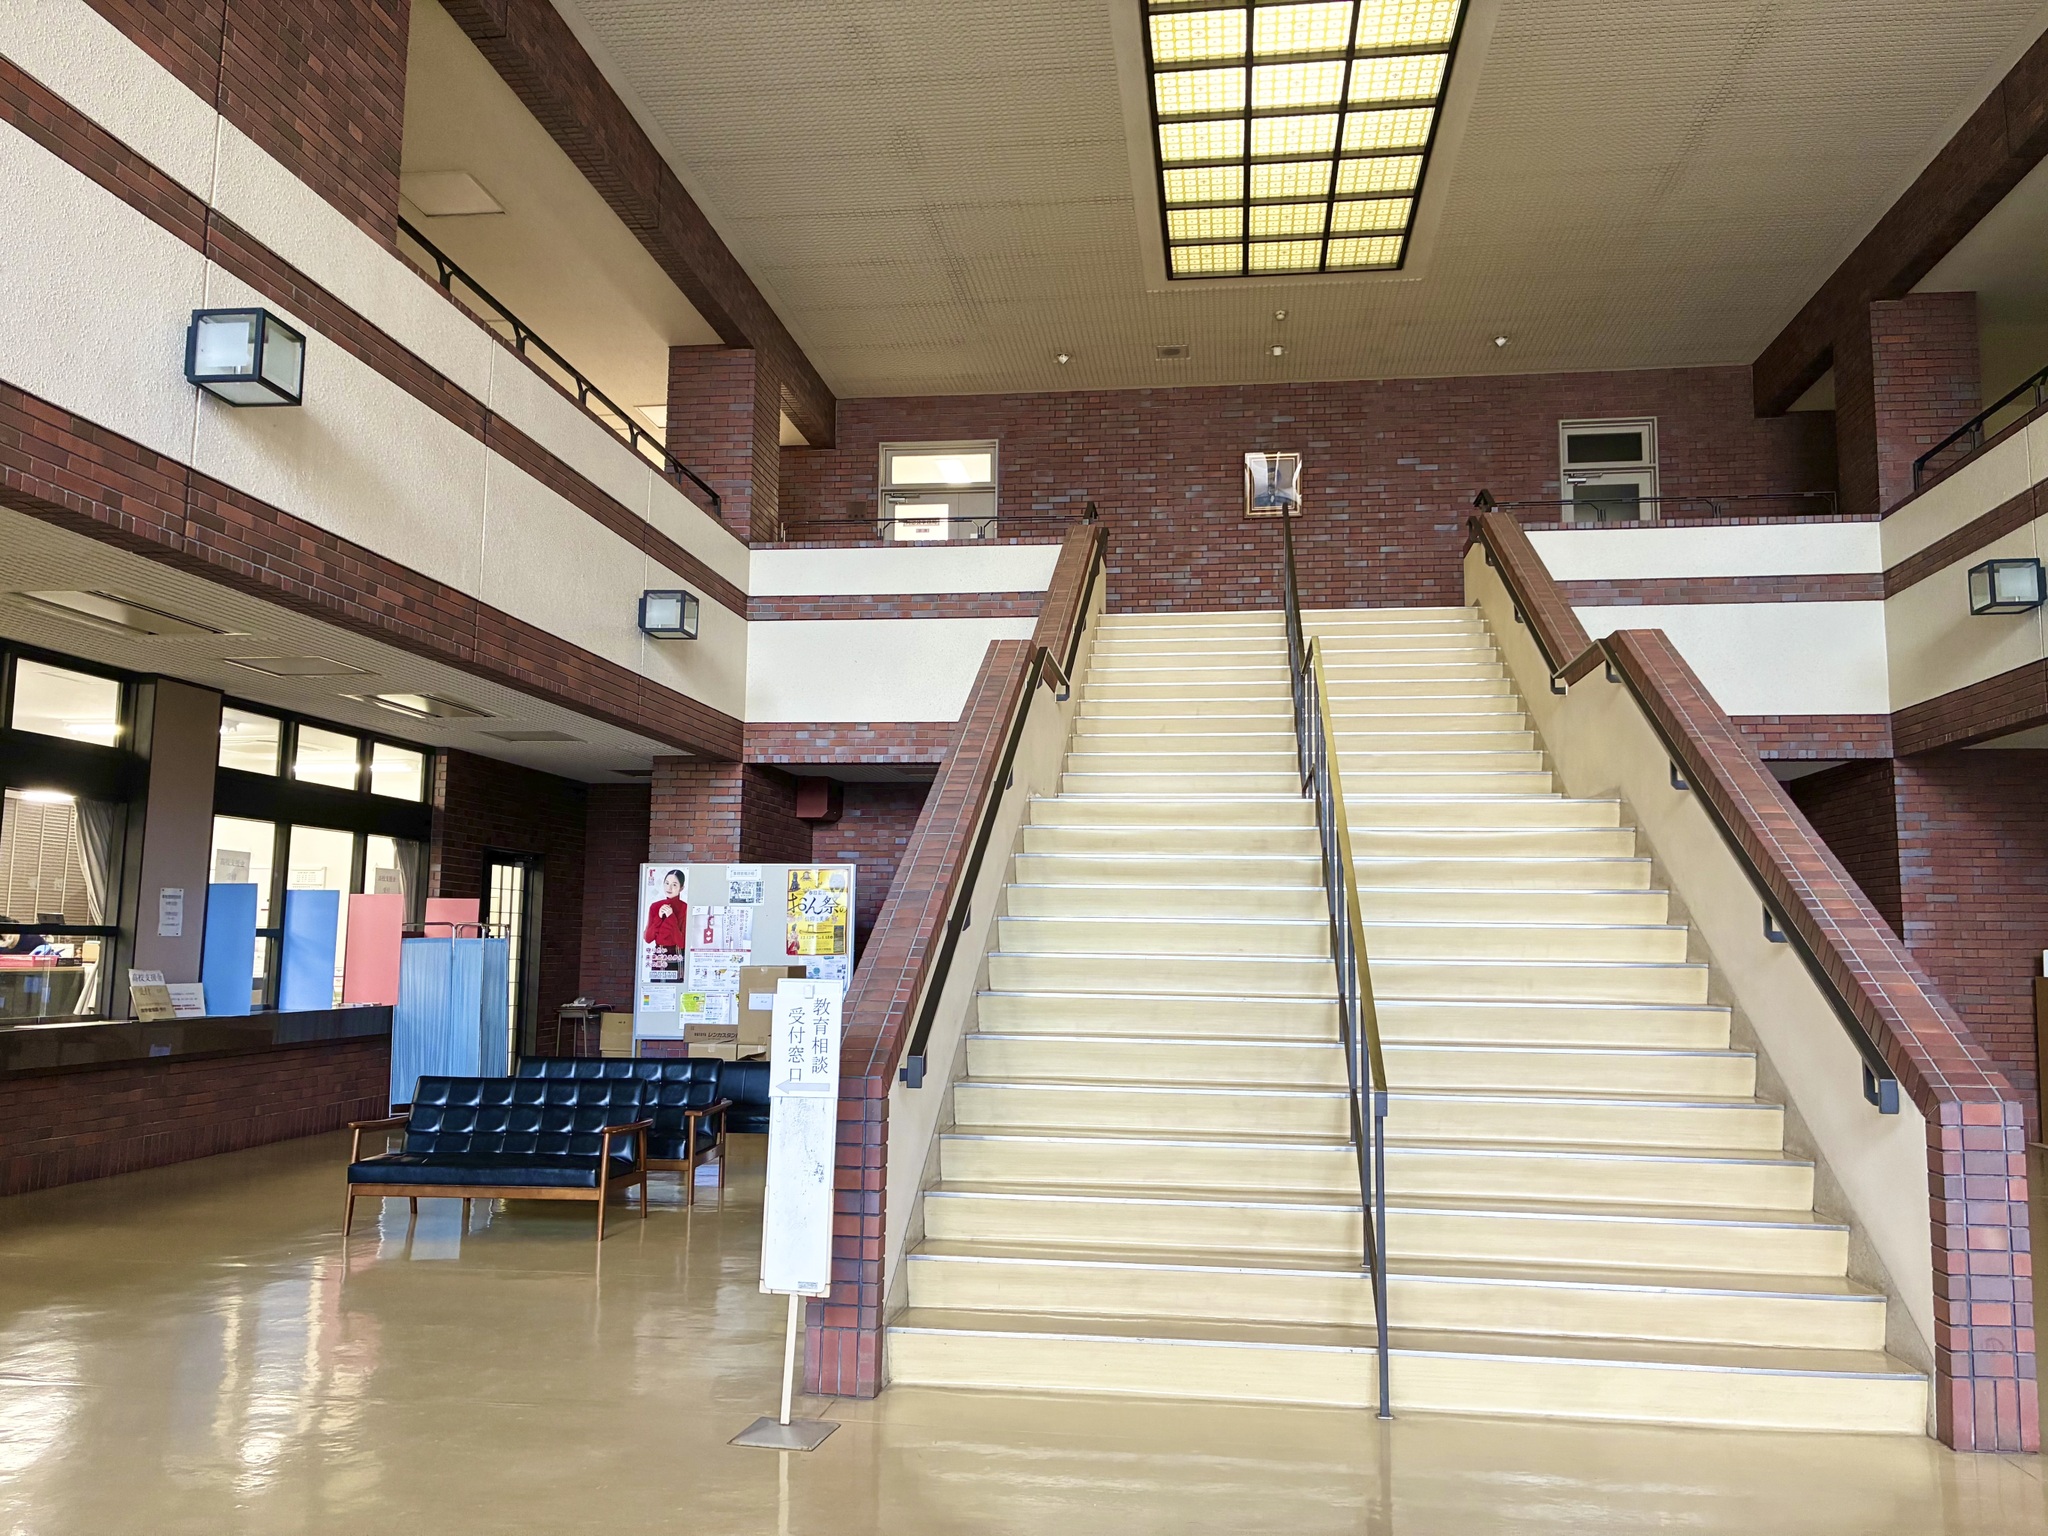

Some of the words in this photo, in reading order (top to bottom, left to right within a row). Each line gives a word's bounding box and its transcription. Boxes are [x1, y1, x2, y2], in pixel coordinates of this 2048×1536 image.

[787, 893, 848, 916] おん祭の
[132, 973, 163, 982] 高校支援金
[788, 1007, 805, 1081] 受付窓口
[812, 998, 830, 1073] 教育相談
